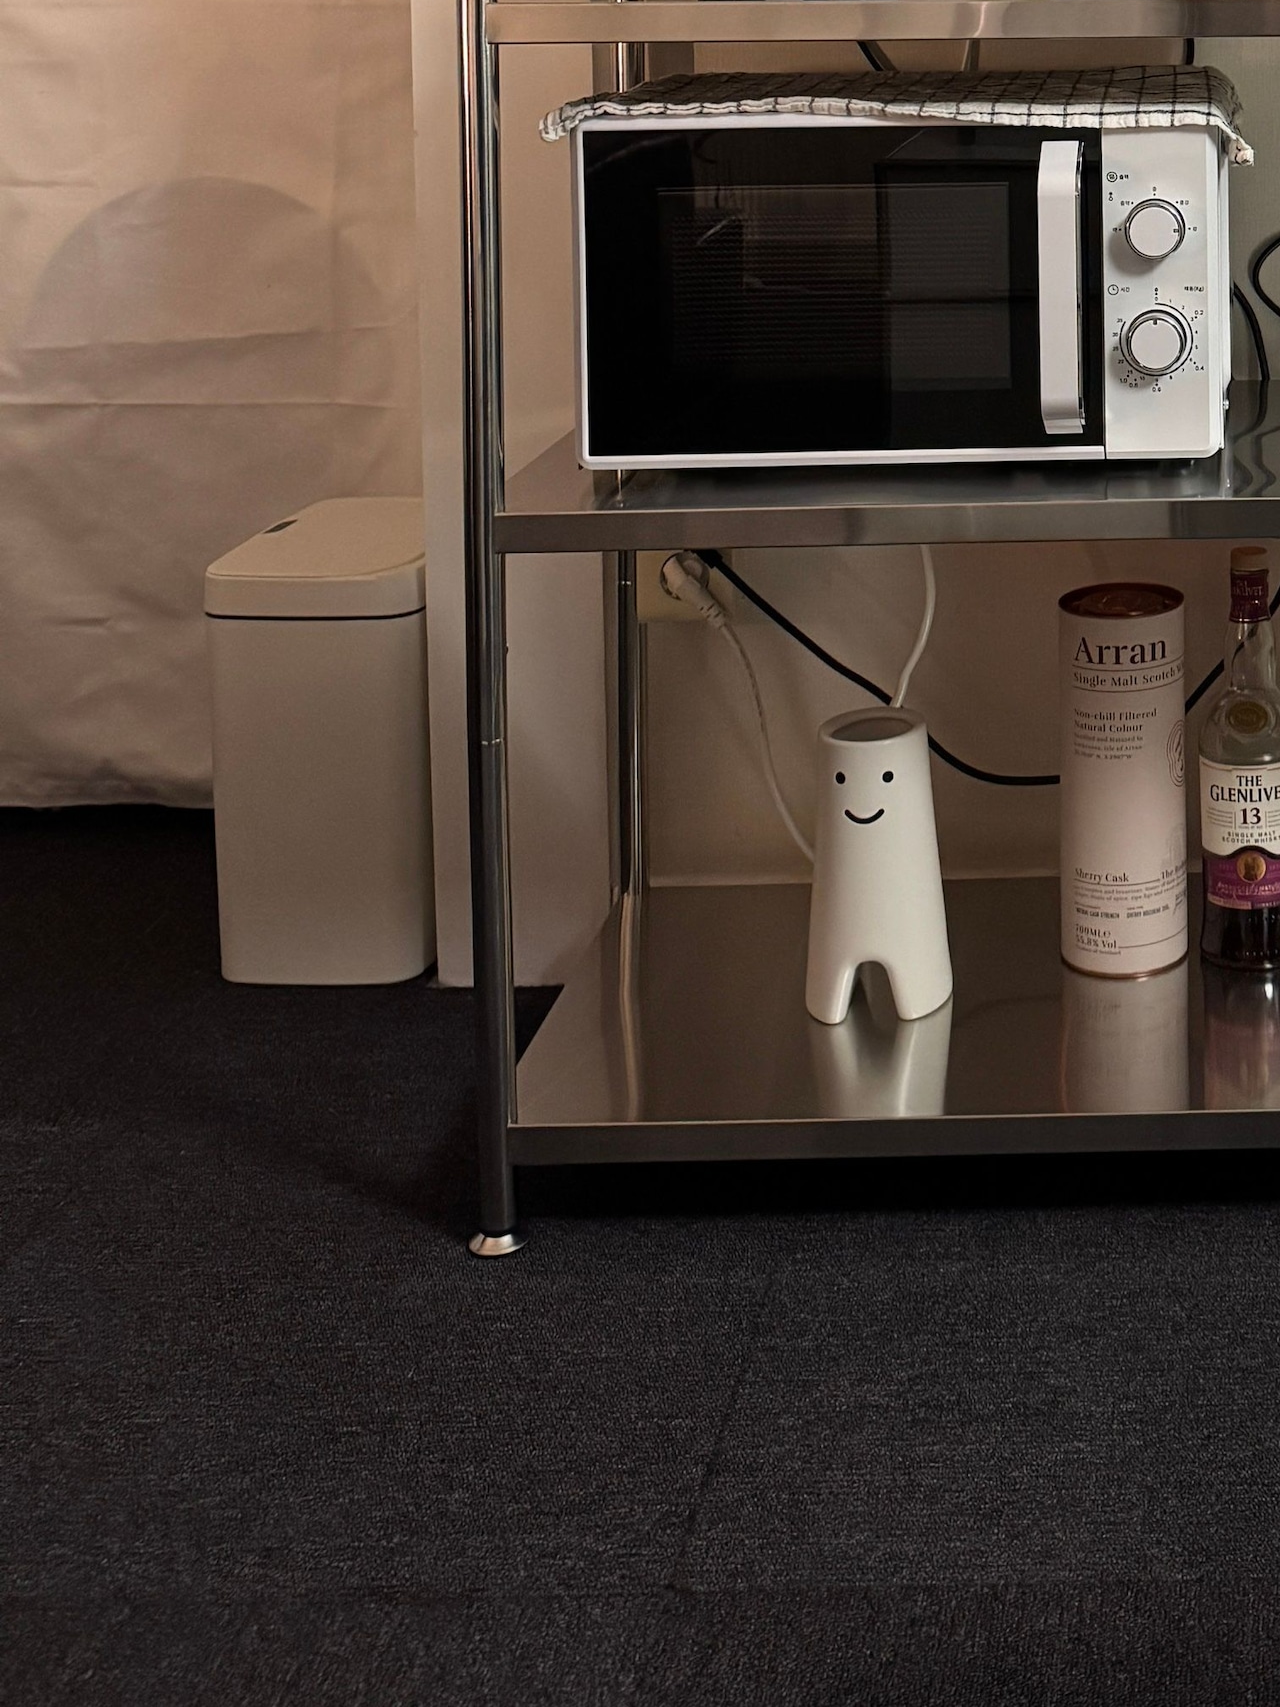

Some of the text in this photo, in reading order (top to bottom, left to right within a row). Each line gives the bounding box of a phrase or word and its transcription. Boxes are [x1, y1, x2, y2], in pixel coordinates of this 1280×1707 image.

[1074, 636, 1168, 665] Arran
[1074, 672, 1107, 688] Single
[1110, 675, 1138, 688] Malt
[1142, 667, 1176, 684] Scotch
[1074, 707, 1157, 722] Non-chill Filtered
[1074, 719, 1144, 734] Natural Colour
[1236, 775, 1262, 787] THE
[1240, 807, 1262, 825] 13
[1221, 836, 1251, 844] SCOTCH
[1227, 831, 1254, 839] SINGLE
[1074, 867, 1130, 884] Sherry Cask
[1101, 940, 1117, 949] Vol
